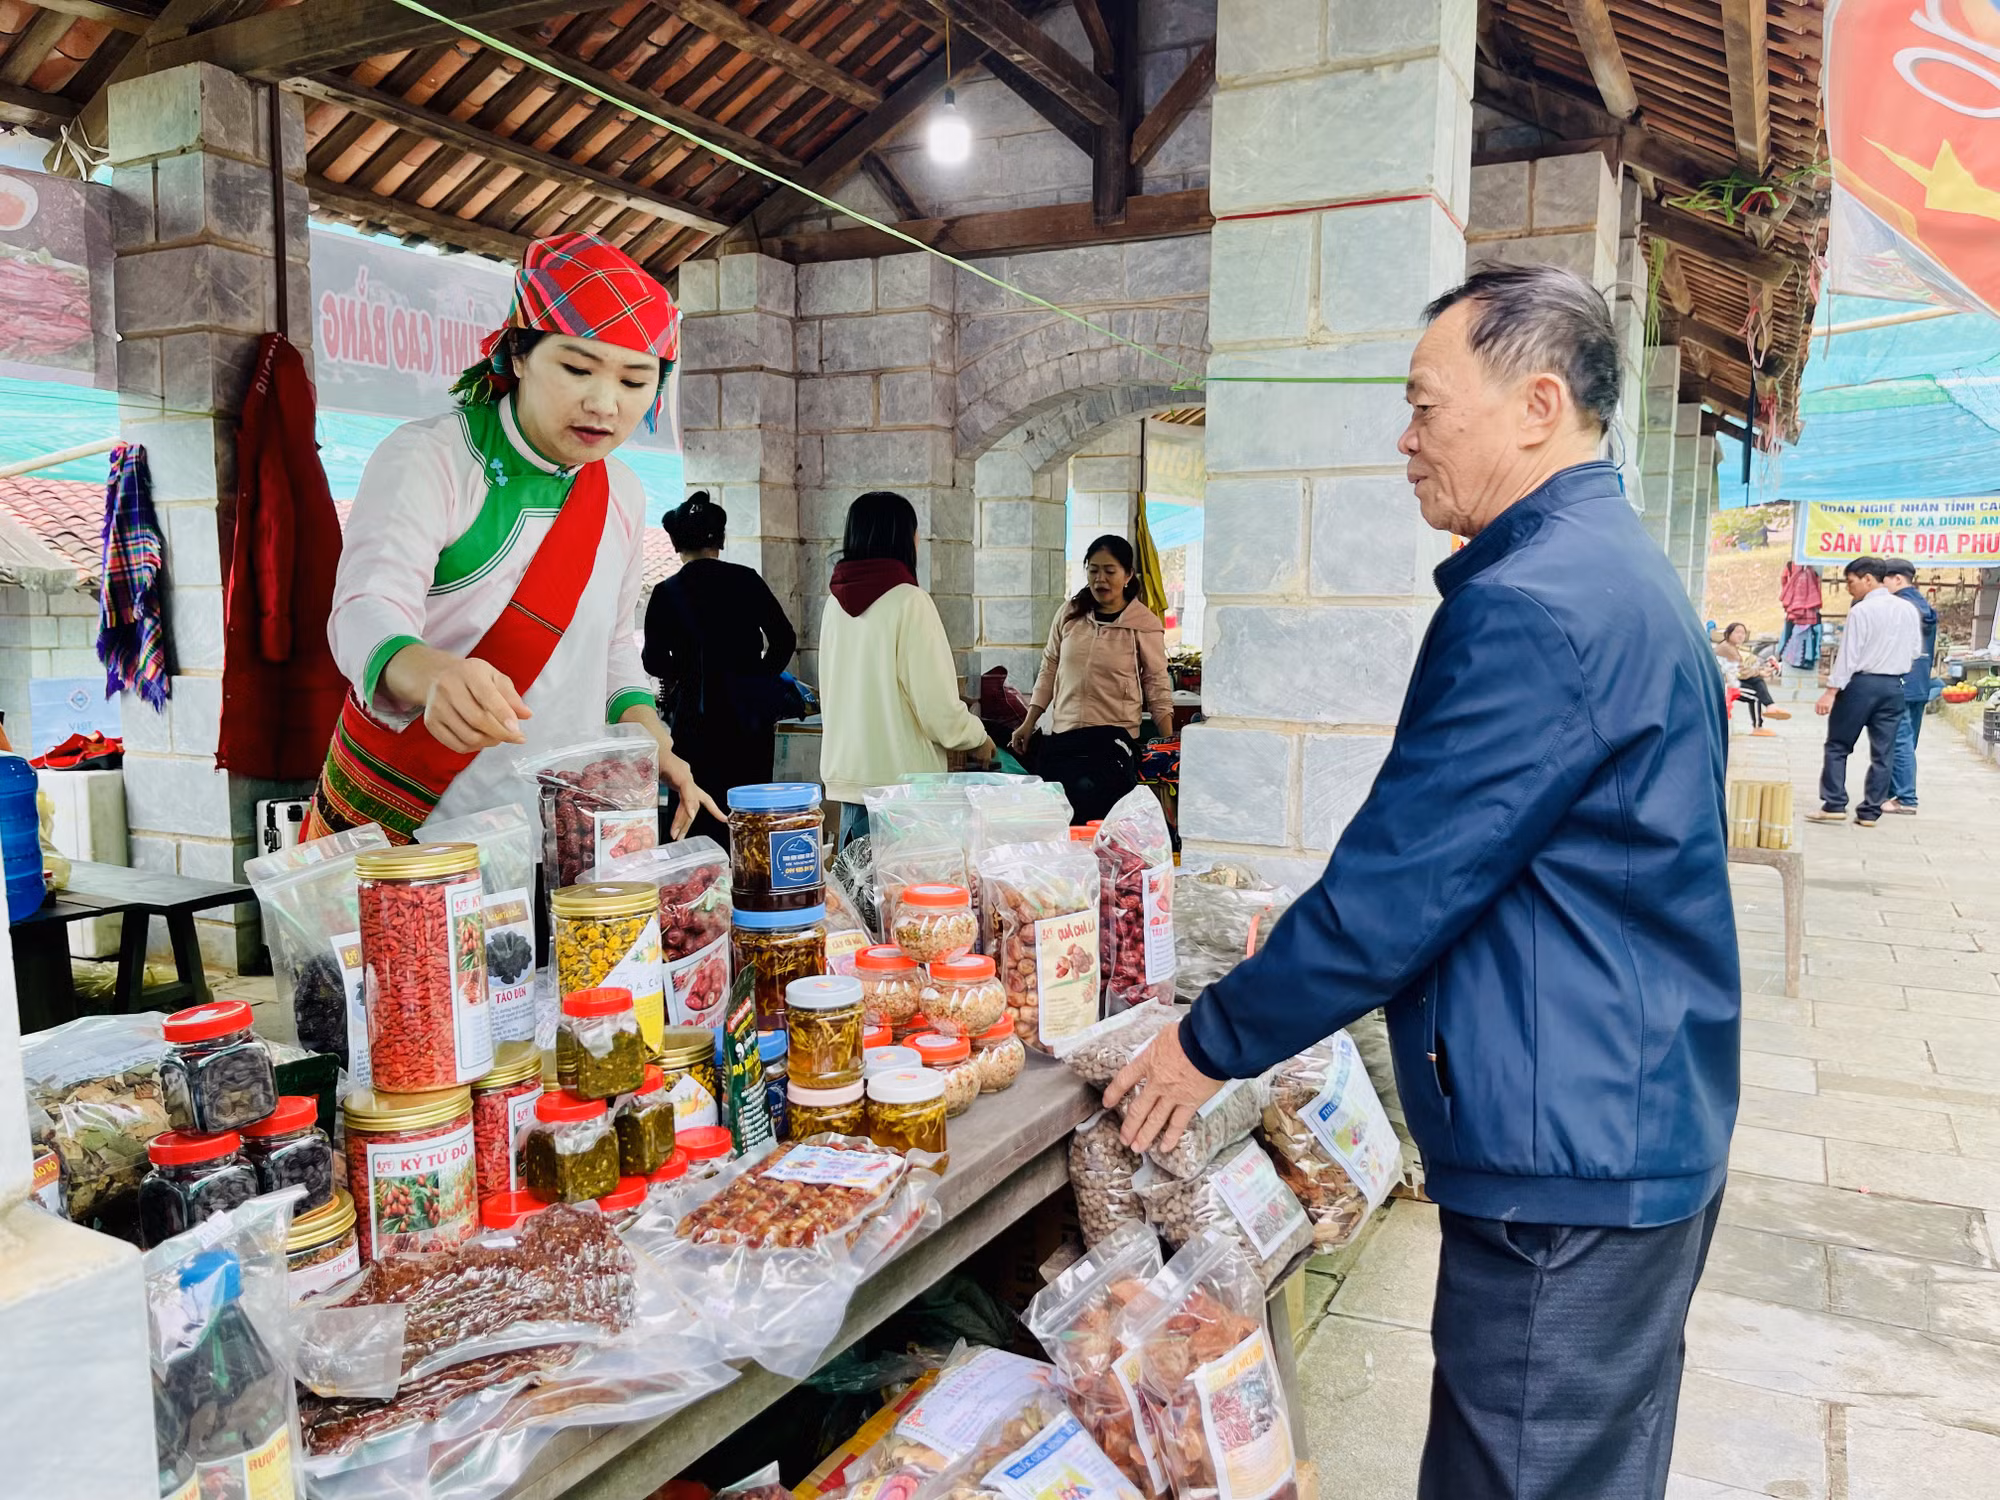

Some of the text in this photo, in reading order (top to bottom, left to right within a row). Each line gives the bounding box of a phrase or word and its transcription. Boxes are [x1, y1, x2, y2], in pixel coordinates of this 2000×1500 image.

[1980, 502, 2000, 511] CA
[1914, 534, 1949, 558] ĐỊA
[451, 1140, 468, 1160] ĐỎ
